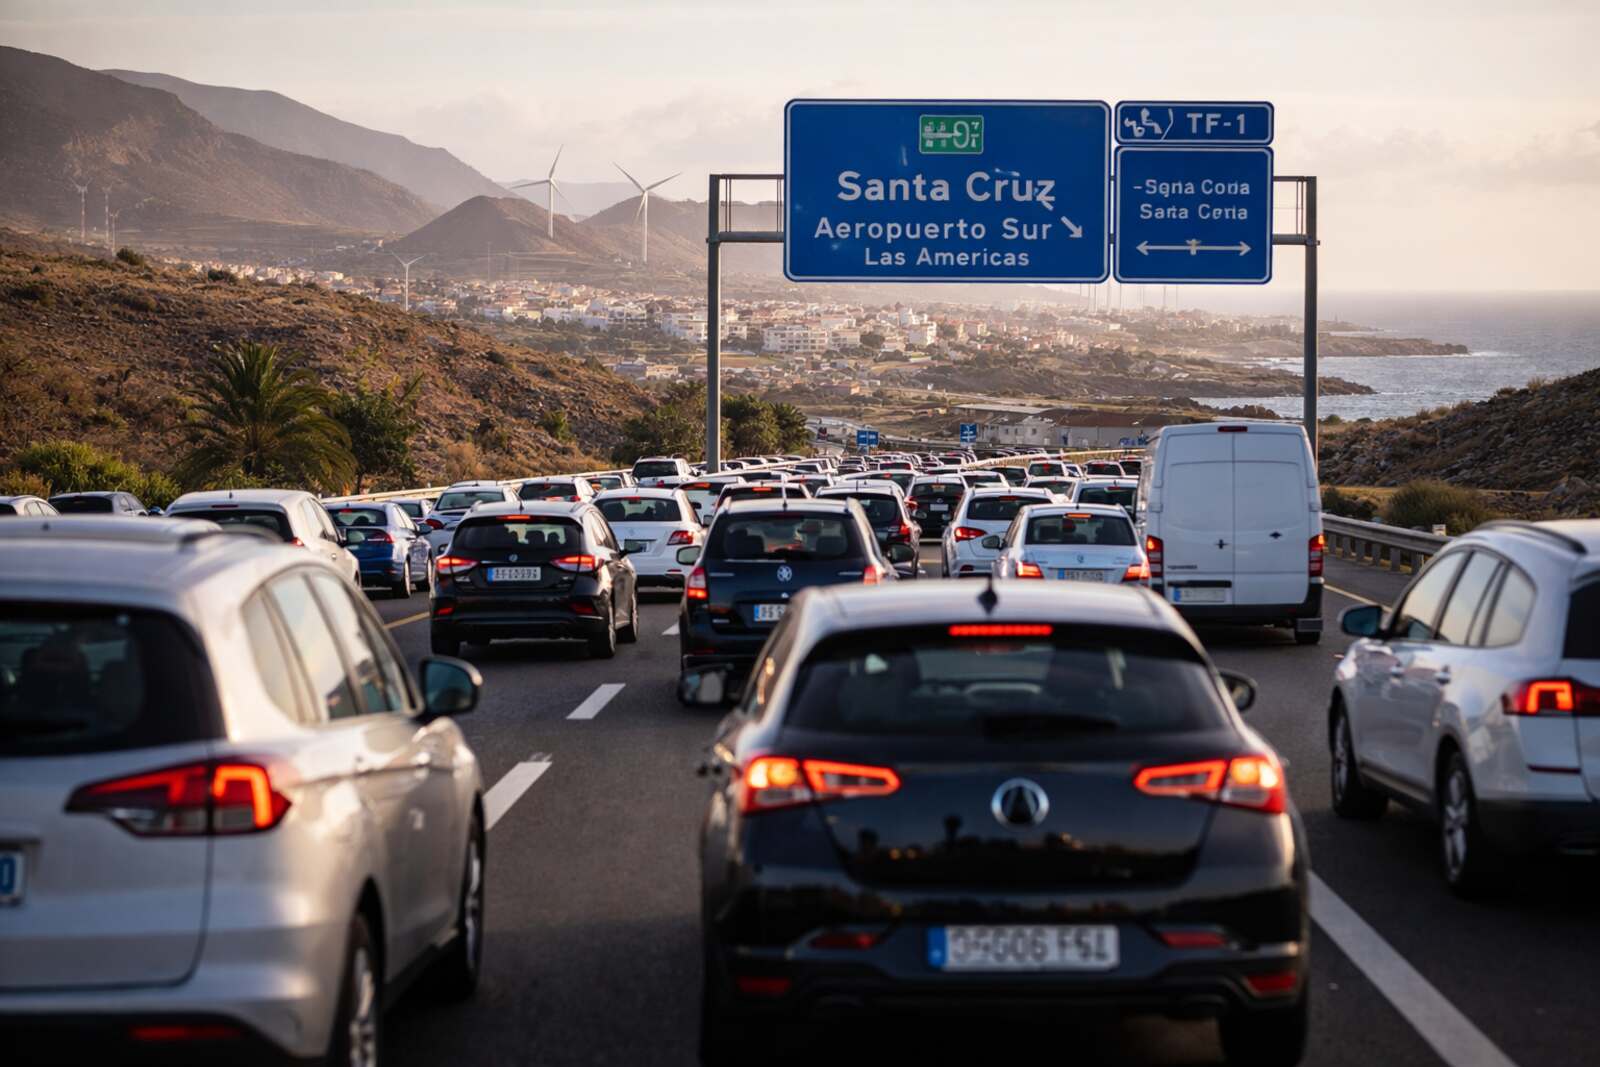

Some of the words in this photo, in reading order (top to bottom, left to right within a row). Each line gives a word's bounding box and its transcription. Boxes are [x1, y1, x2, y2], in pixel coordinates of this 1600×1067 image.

[1187, 113, 1244, 134] TF-1
[838, 171, 949, 201] Santa
[966, 171, 1055, 202] Cruz
[814, 217, 986, 243] Aeropuerto
[1002, 218, 1051, 240] Sur
[865, 247, 906, 266] Las
[916, 247, 1029, 266] Americas
